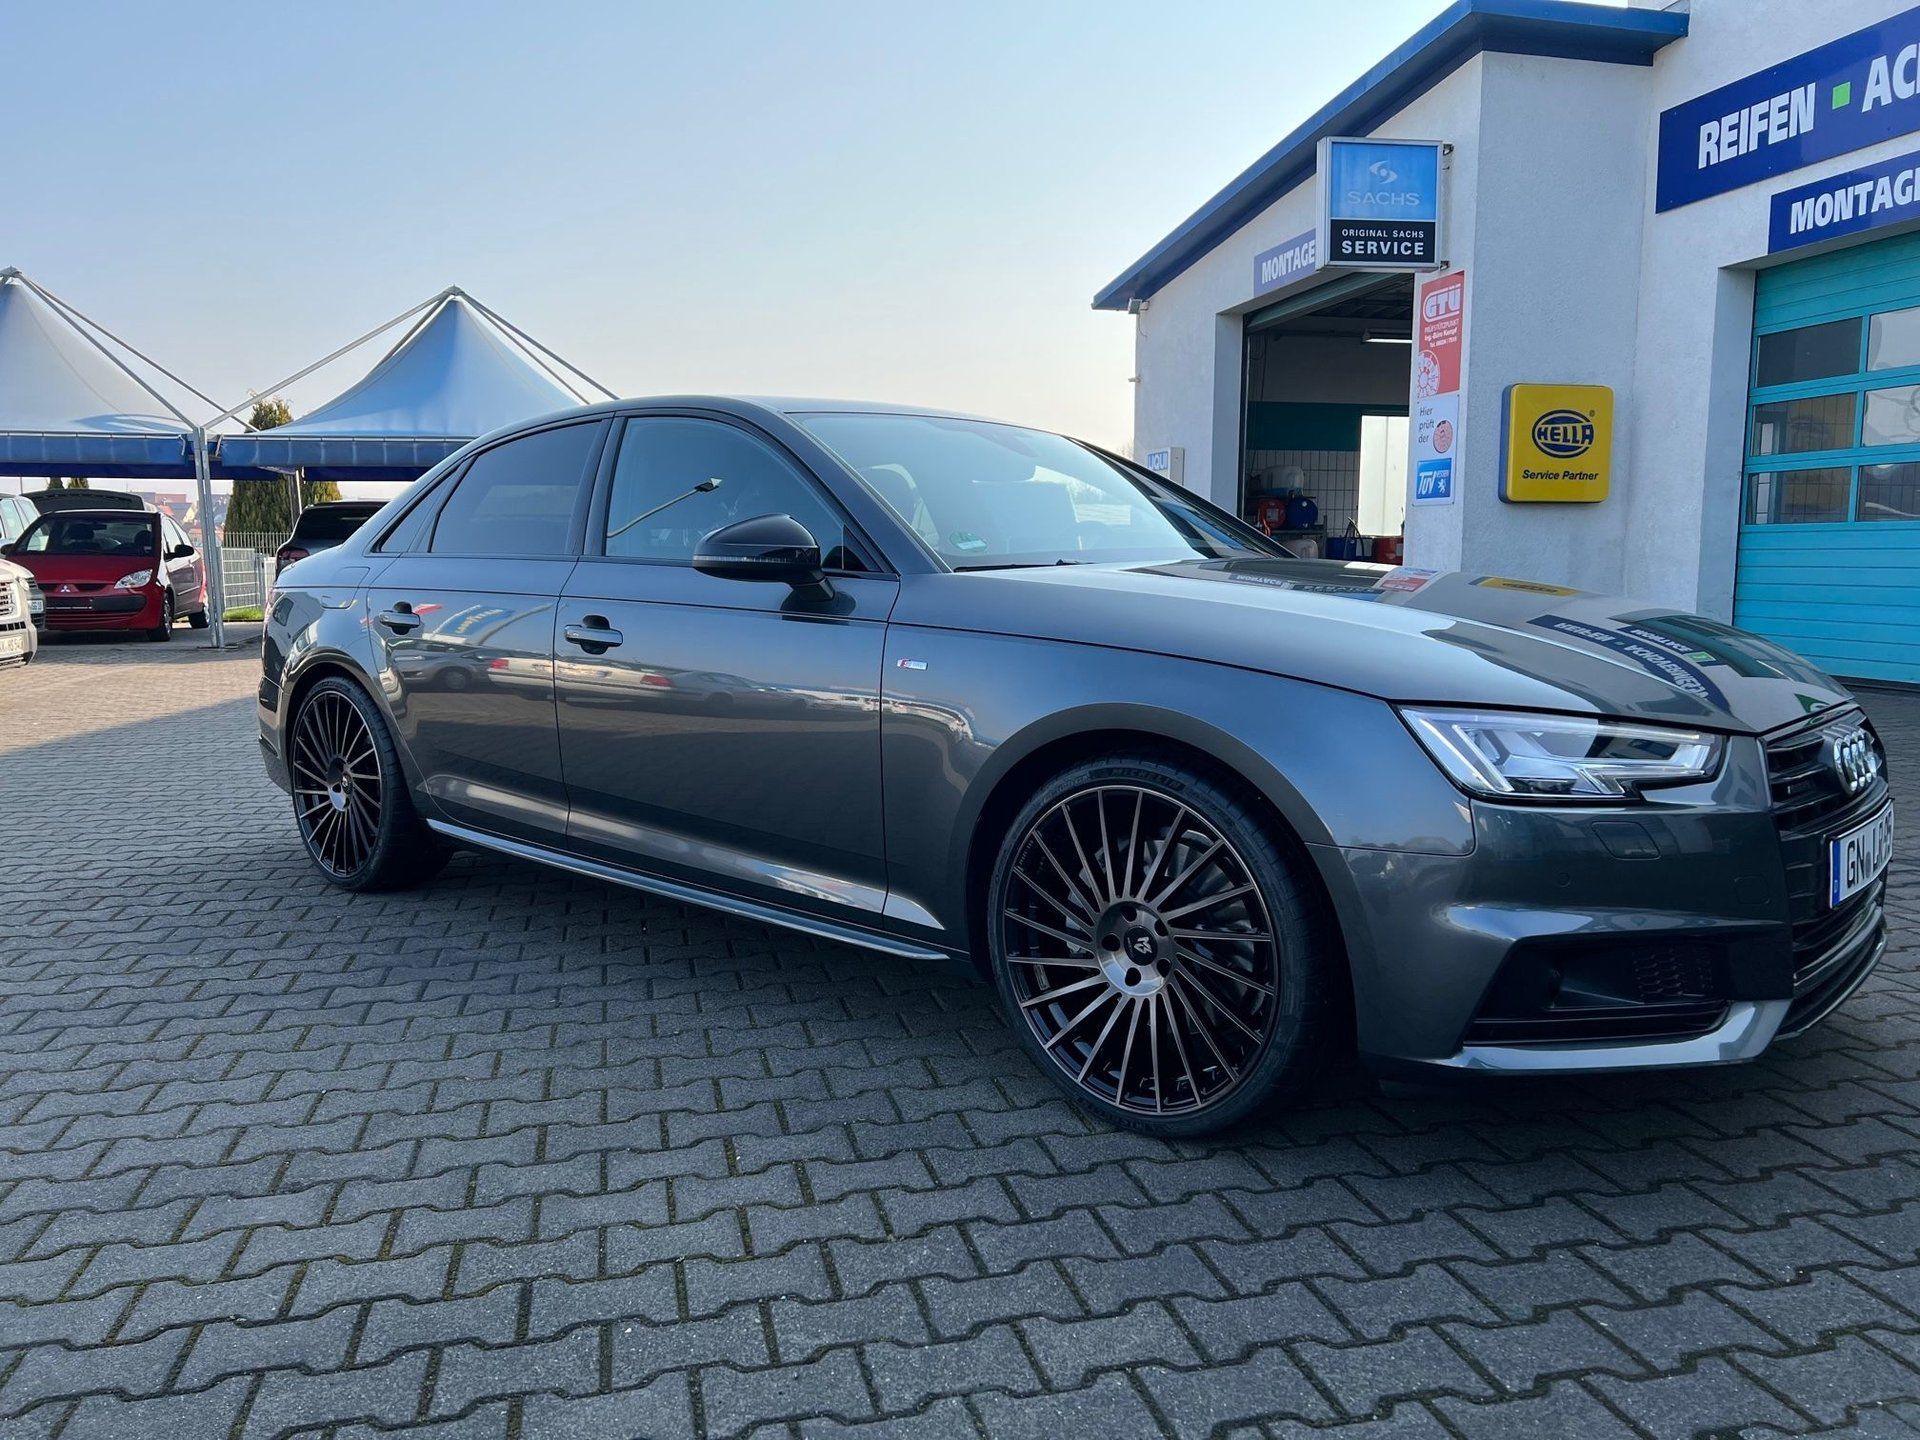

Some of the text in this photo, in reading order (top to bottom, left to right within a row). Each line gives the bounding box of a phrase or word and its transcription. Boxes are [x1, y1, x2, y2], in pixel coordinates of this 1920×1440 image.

[1698, 43, 1920, 170] REIFEN AC
[1347, 191, 1421, 206] SACHS
[1341, 228, 1425, 239] ORIGINAL SACHS
[1341, 240, 1425, 256] SERVICE
[1262, 240, 1316, 285] MONTAGE
[1419, 406, 1434, 416] Hier
[1418, 419, 1435, 431] prüft
[1418, 433, 1429, 443] der
[1536, 423, 1594, 445] HELLA
[1522, 469, 1599, 481] Service Partner
[1846, 834, 1865, 889] GN
